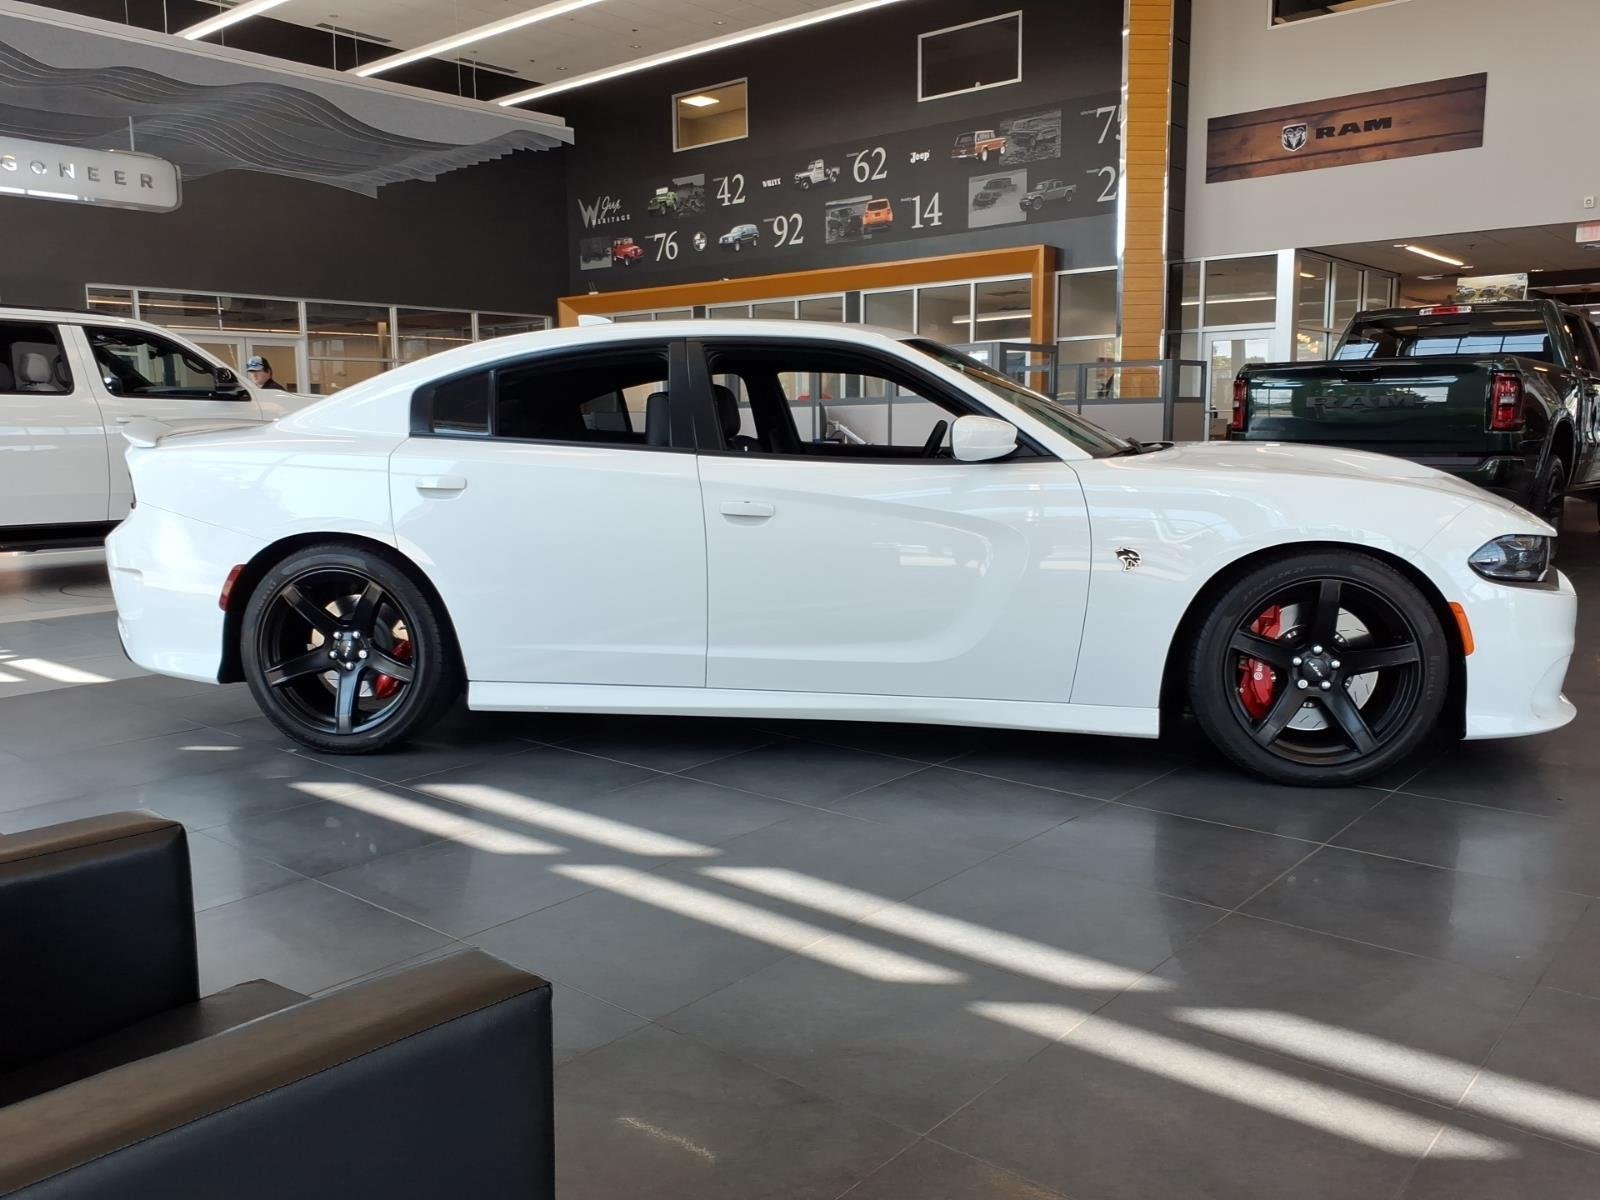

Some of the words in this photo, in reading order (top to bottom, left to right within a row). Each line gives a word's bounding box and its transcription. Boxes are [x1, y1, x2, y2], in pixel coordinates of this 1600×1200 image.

[1315, 117, 1392, 140] RAM
[853, 147, 888, 183] 62
[910, 150, 930, 164] Jeep
[716, 173, 746, 206] 42
[911, 192, 943, 229] 14
[654, 231, 678, 262] 76
[773, 213, 804, 248] 92
